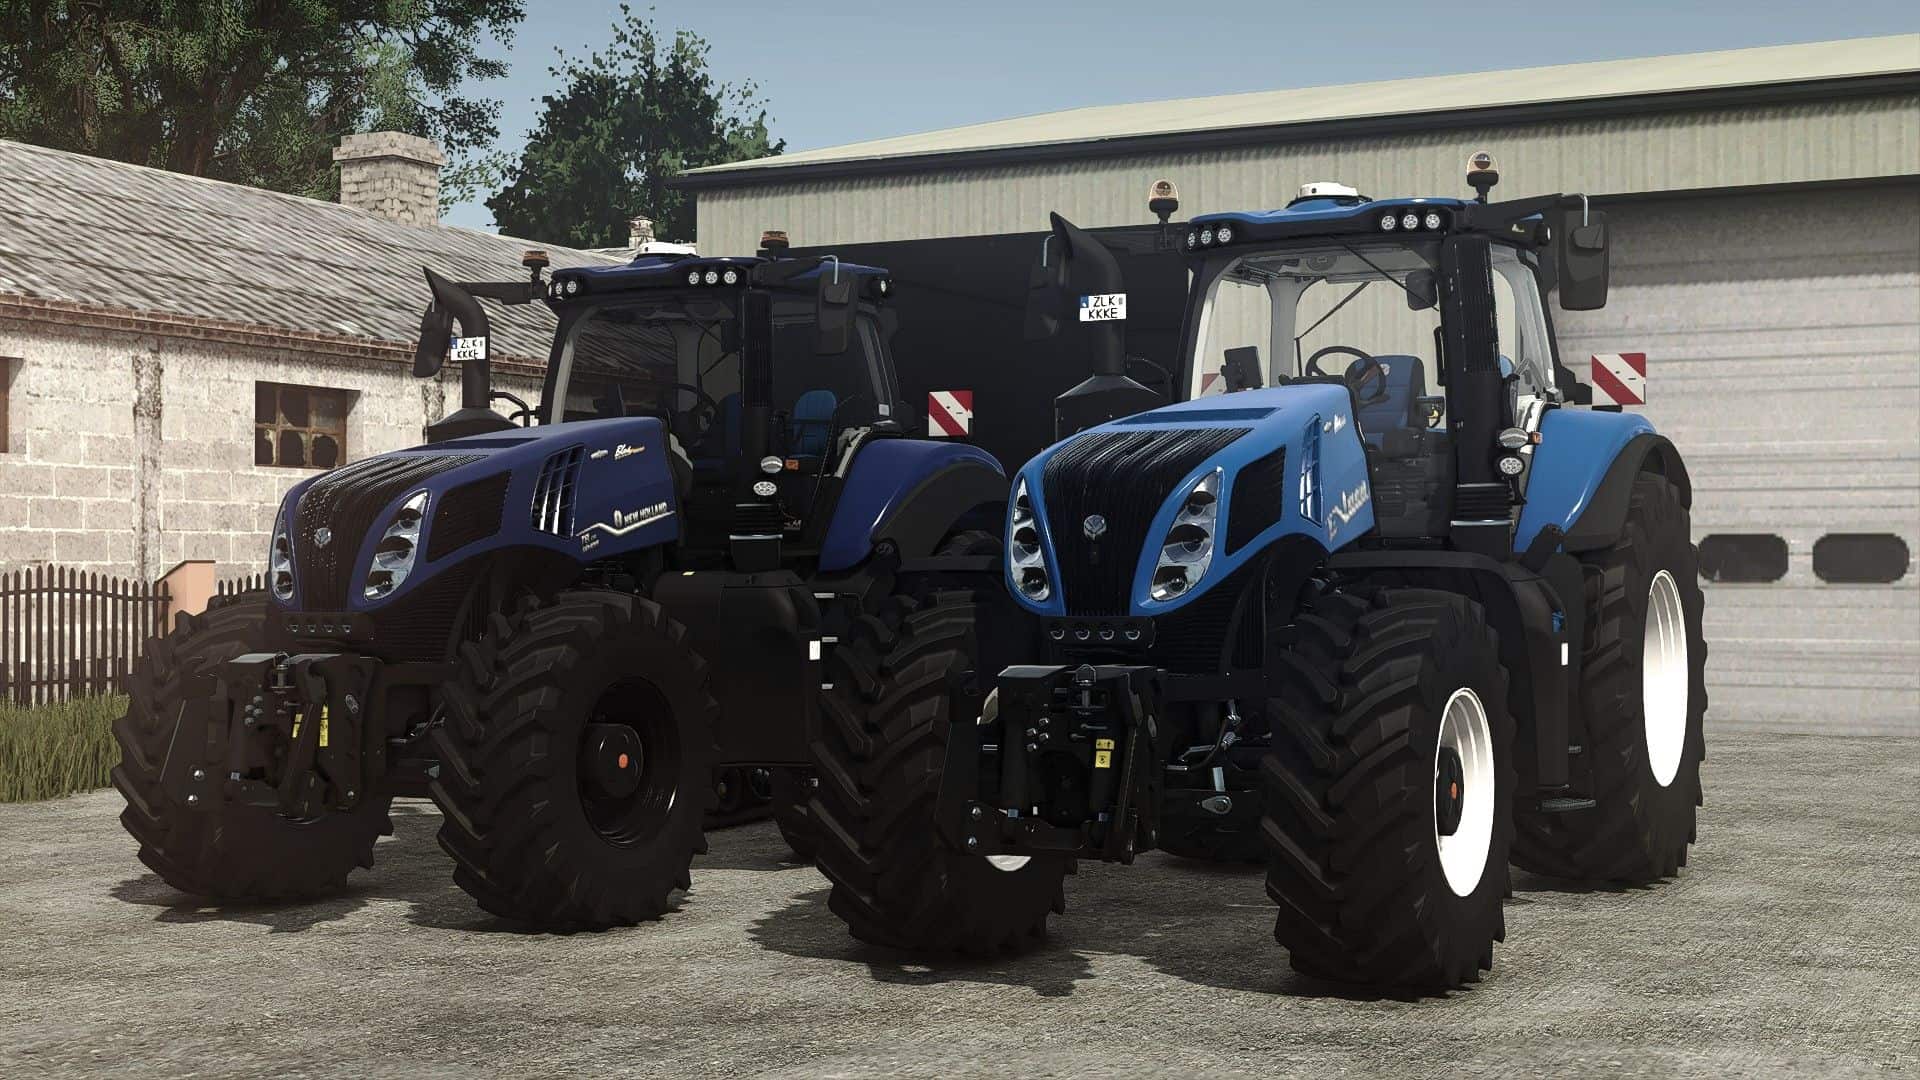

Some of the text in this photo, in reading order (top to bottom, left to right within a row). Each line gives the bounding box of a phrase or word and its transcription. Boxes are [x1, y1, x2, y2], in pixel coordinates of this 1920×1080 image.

[1093, 295, 1116, 307] ZLK
[1088, 307, 1118, 319] KKKE
[623, 501, 668, 526] NEW HOLLAND
